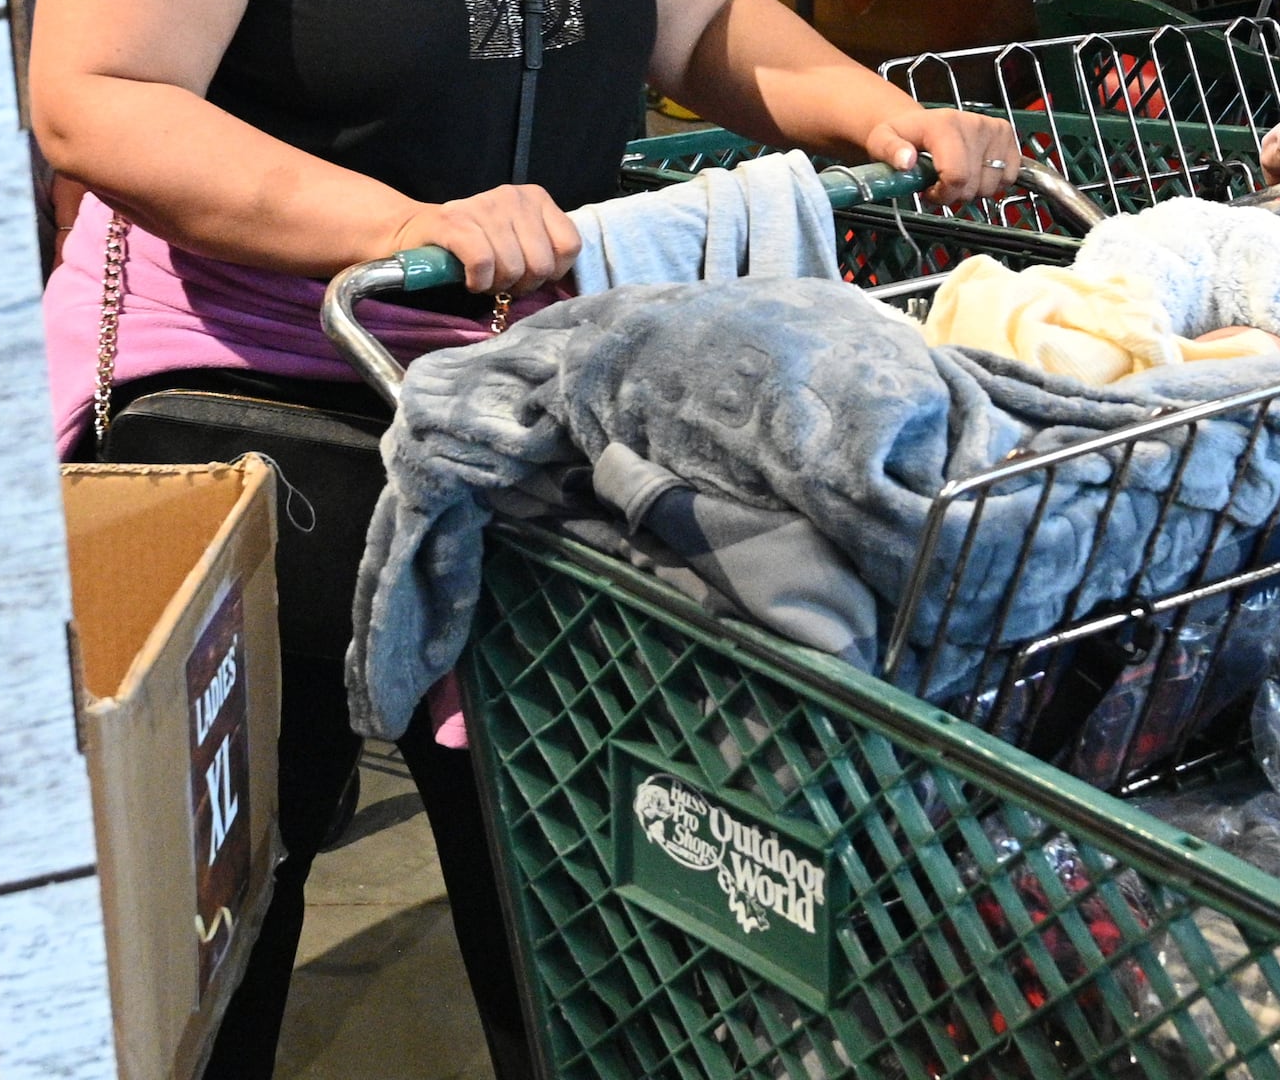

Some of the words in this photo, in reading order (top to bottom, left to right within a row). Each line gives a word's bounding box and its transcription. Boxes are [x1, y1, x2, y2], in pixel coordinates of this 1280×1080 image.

[205, 733, 239, 867] XL
[671, 778, 708, 816] Bass
[672, 806, 700, 833] Pro
[672, 822, 719, 863] Shops
[709, 806, 825, 905] Outdoor
[729, 849, 816, 934] World
